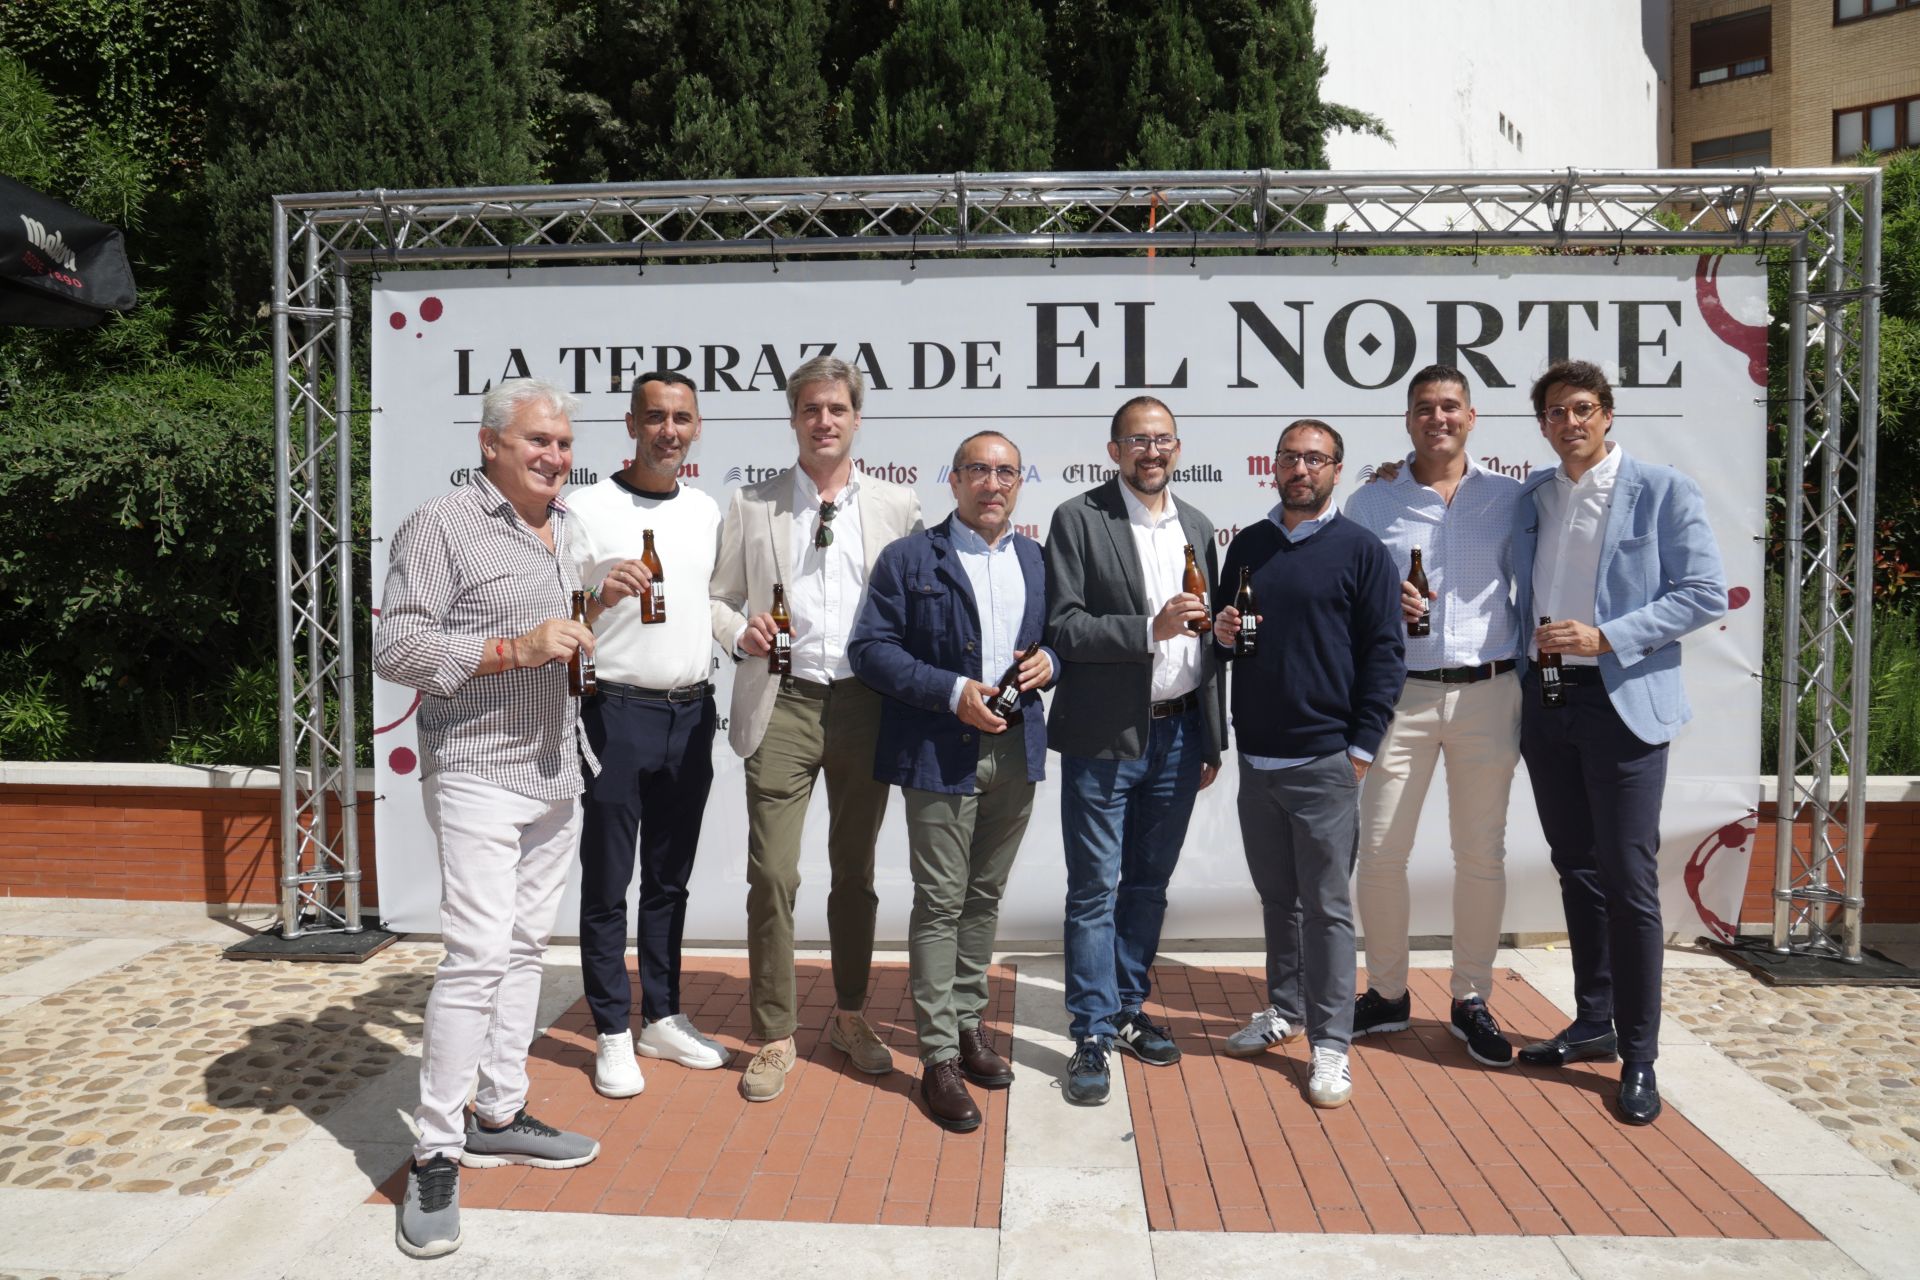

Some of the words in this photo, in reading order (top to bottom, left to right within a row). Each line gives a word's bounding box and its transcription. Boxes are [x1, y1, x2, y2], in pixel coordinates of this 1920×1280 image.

[454, 349, 532, 396] LA
[908, 341, 1001, 390] DE
[1027, 301, 1188, 389] EL
[1227, 299, 1682, 390] NORTE
[1172, 464, 1223, 482] astilla
